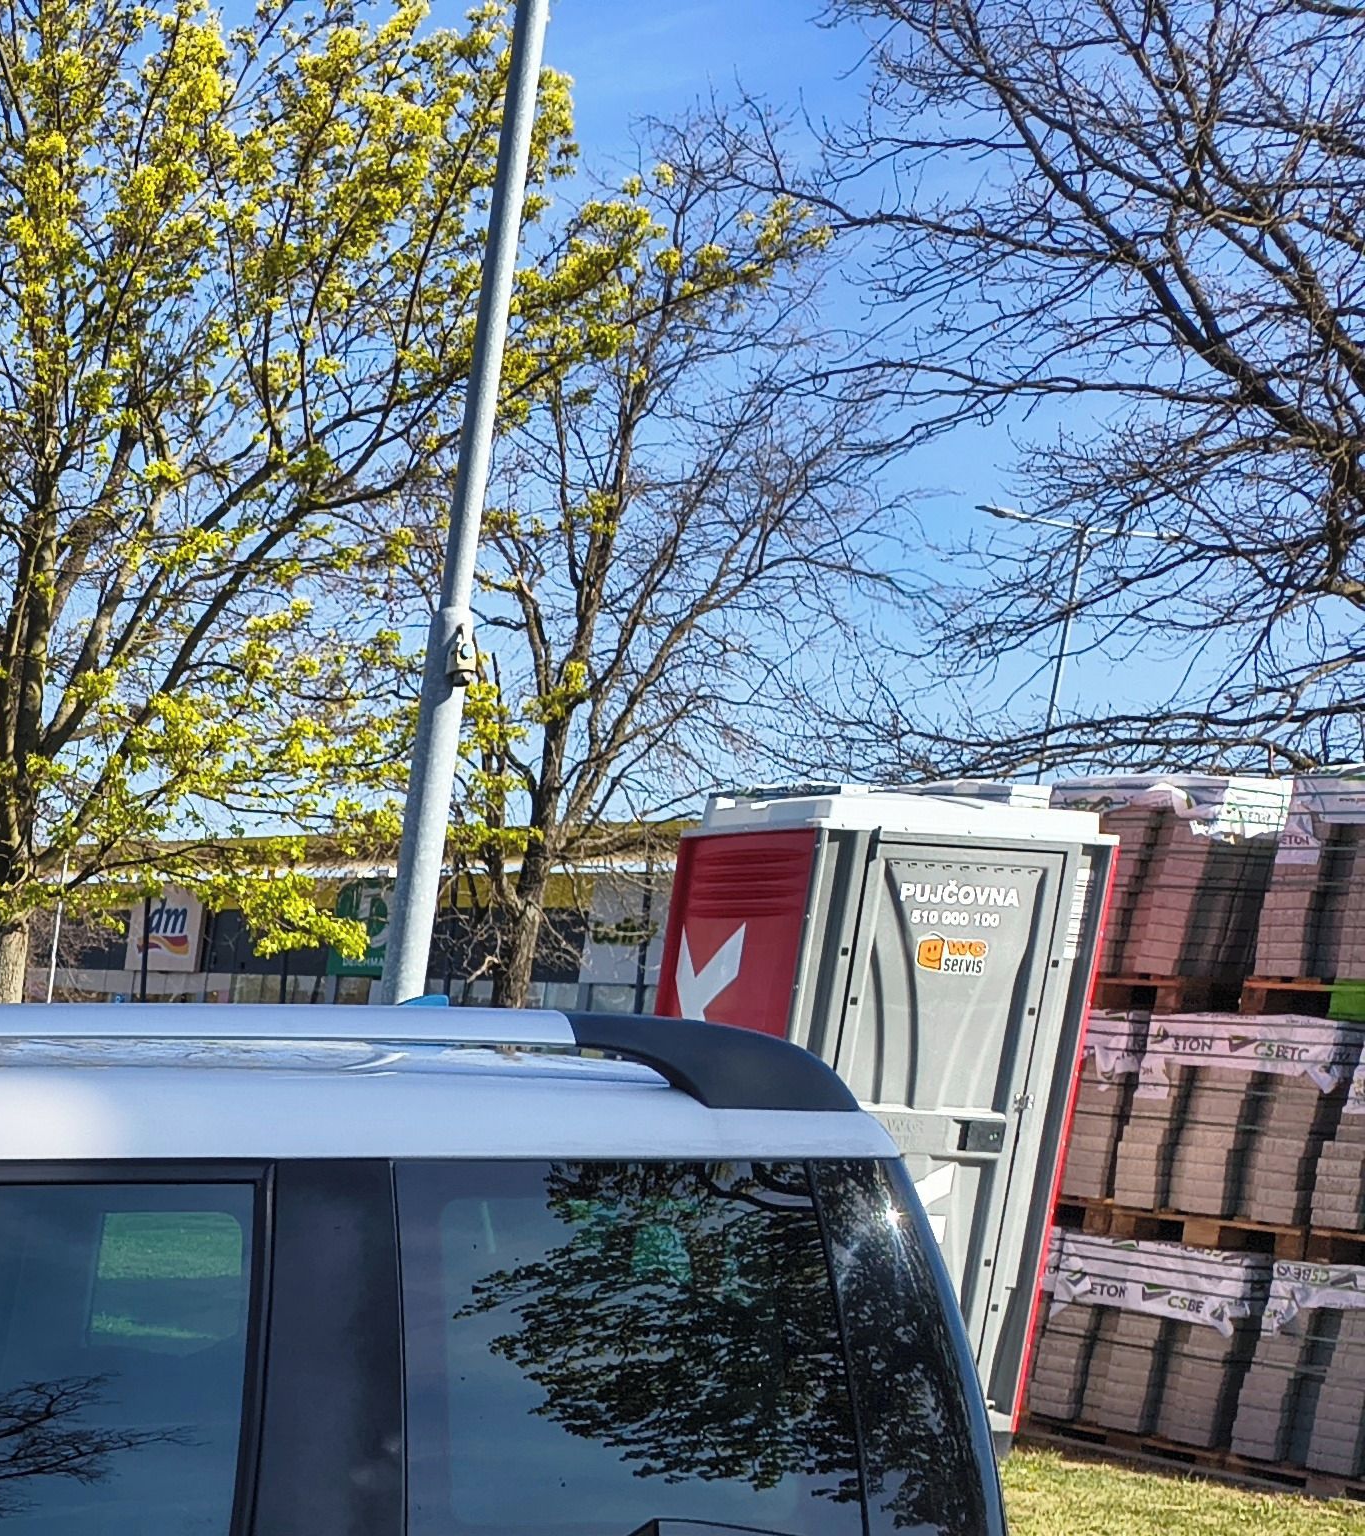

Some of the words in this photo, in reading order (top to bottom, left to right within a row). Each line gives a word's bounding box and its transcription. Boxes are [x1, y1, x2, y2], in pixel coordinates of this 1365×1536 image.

[147, 901, 189, 935] dm
[942, 911, 970, 926] 000
[973, 912, 1001, 928] 100
[943, 957, 983, 974] servis
